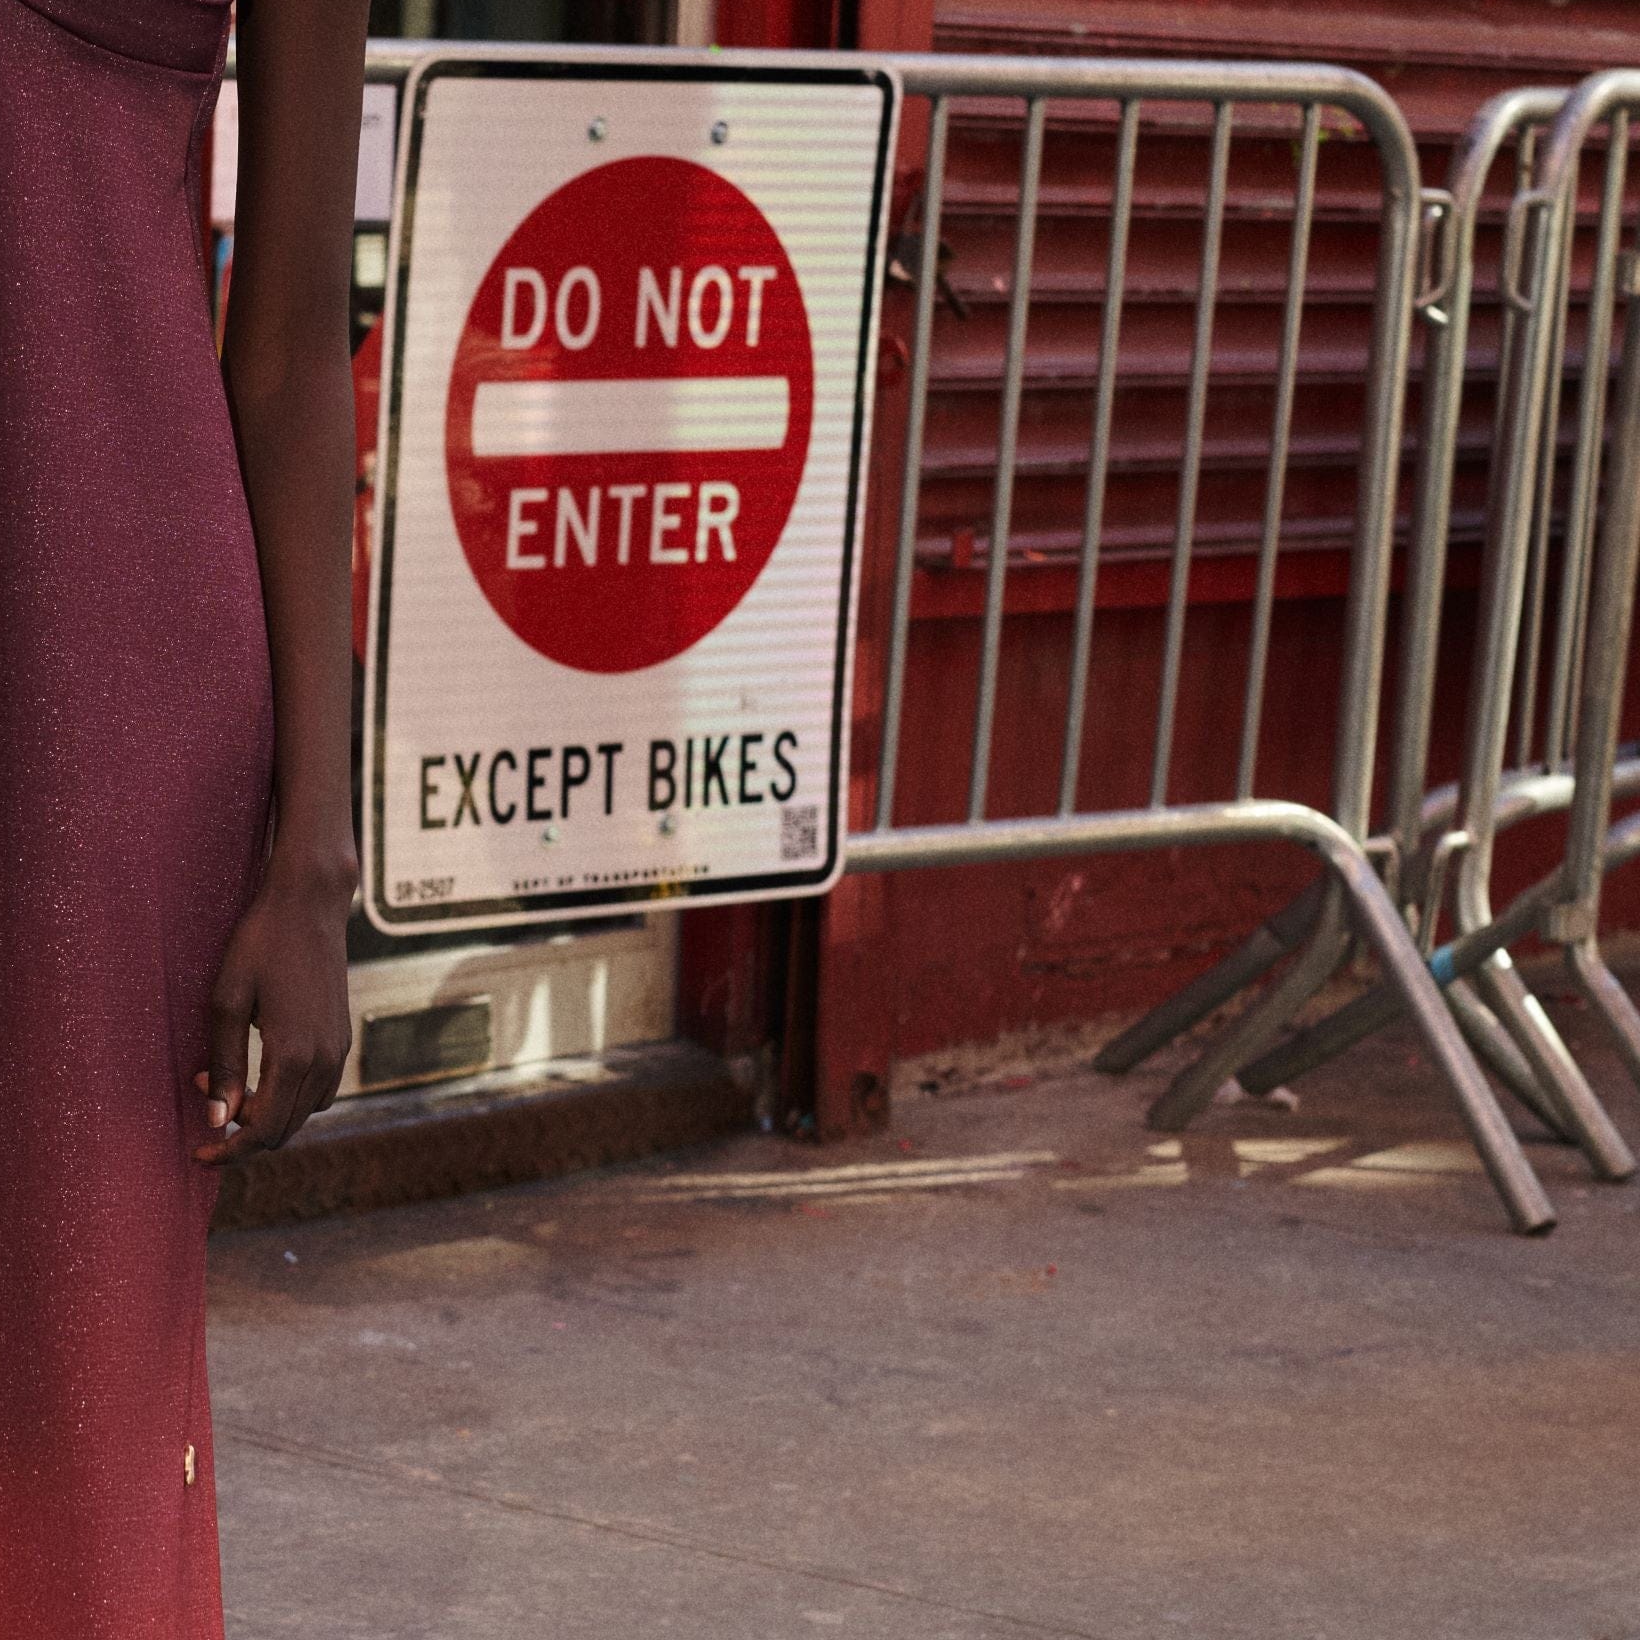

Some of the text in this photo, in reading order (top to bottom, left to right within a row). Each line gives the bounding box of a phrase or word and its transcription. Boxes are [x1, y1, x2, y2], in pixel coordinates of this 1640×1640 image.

[500, 264, 778, 351] DO NOT
[506, 480, 741, 570] ENTER
[419, 730, 799, 830] EXCEPT BIKES
